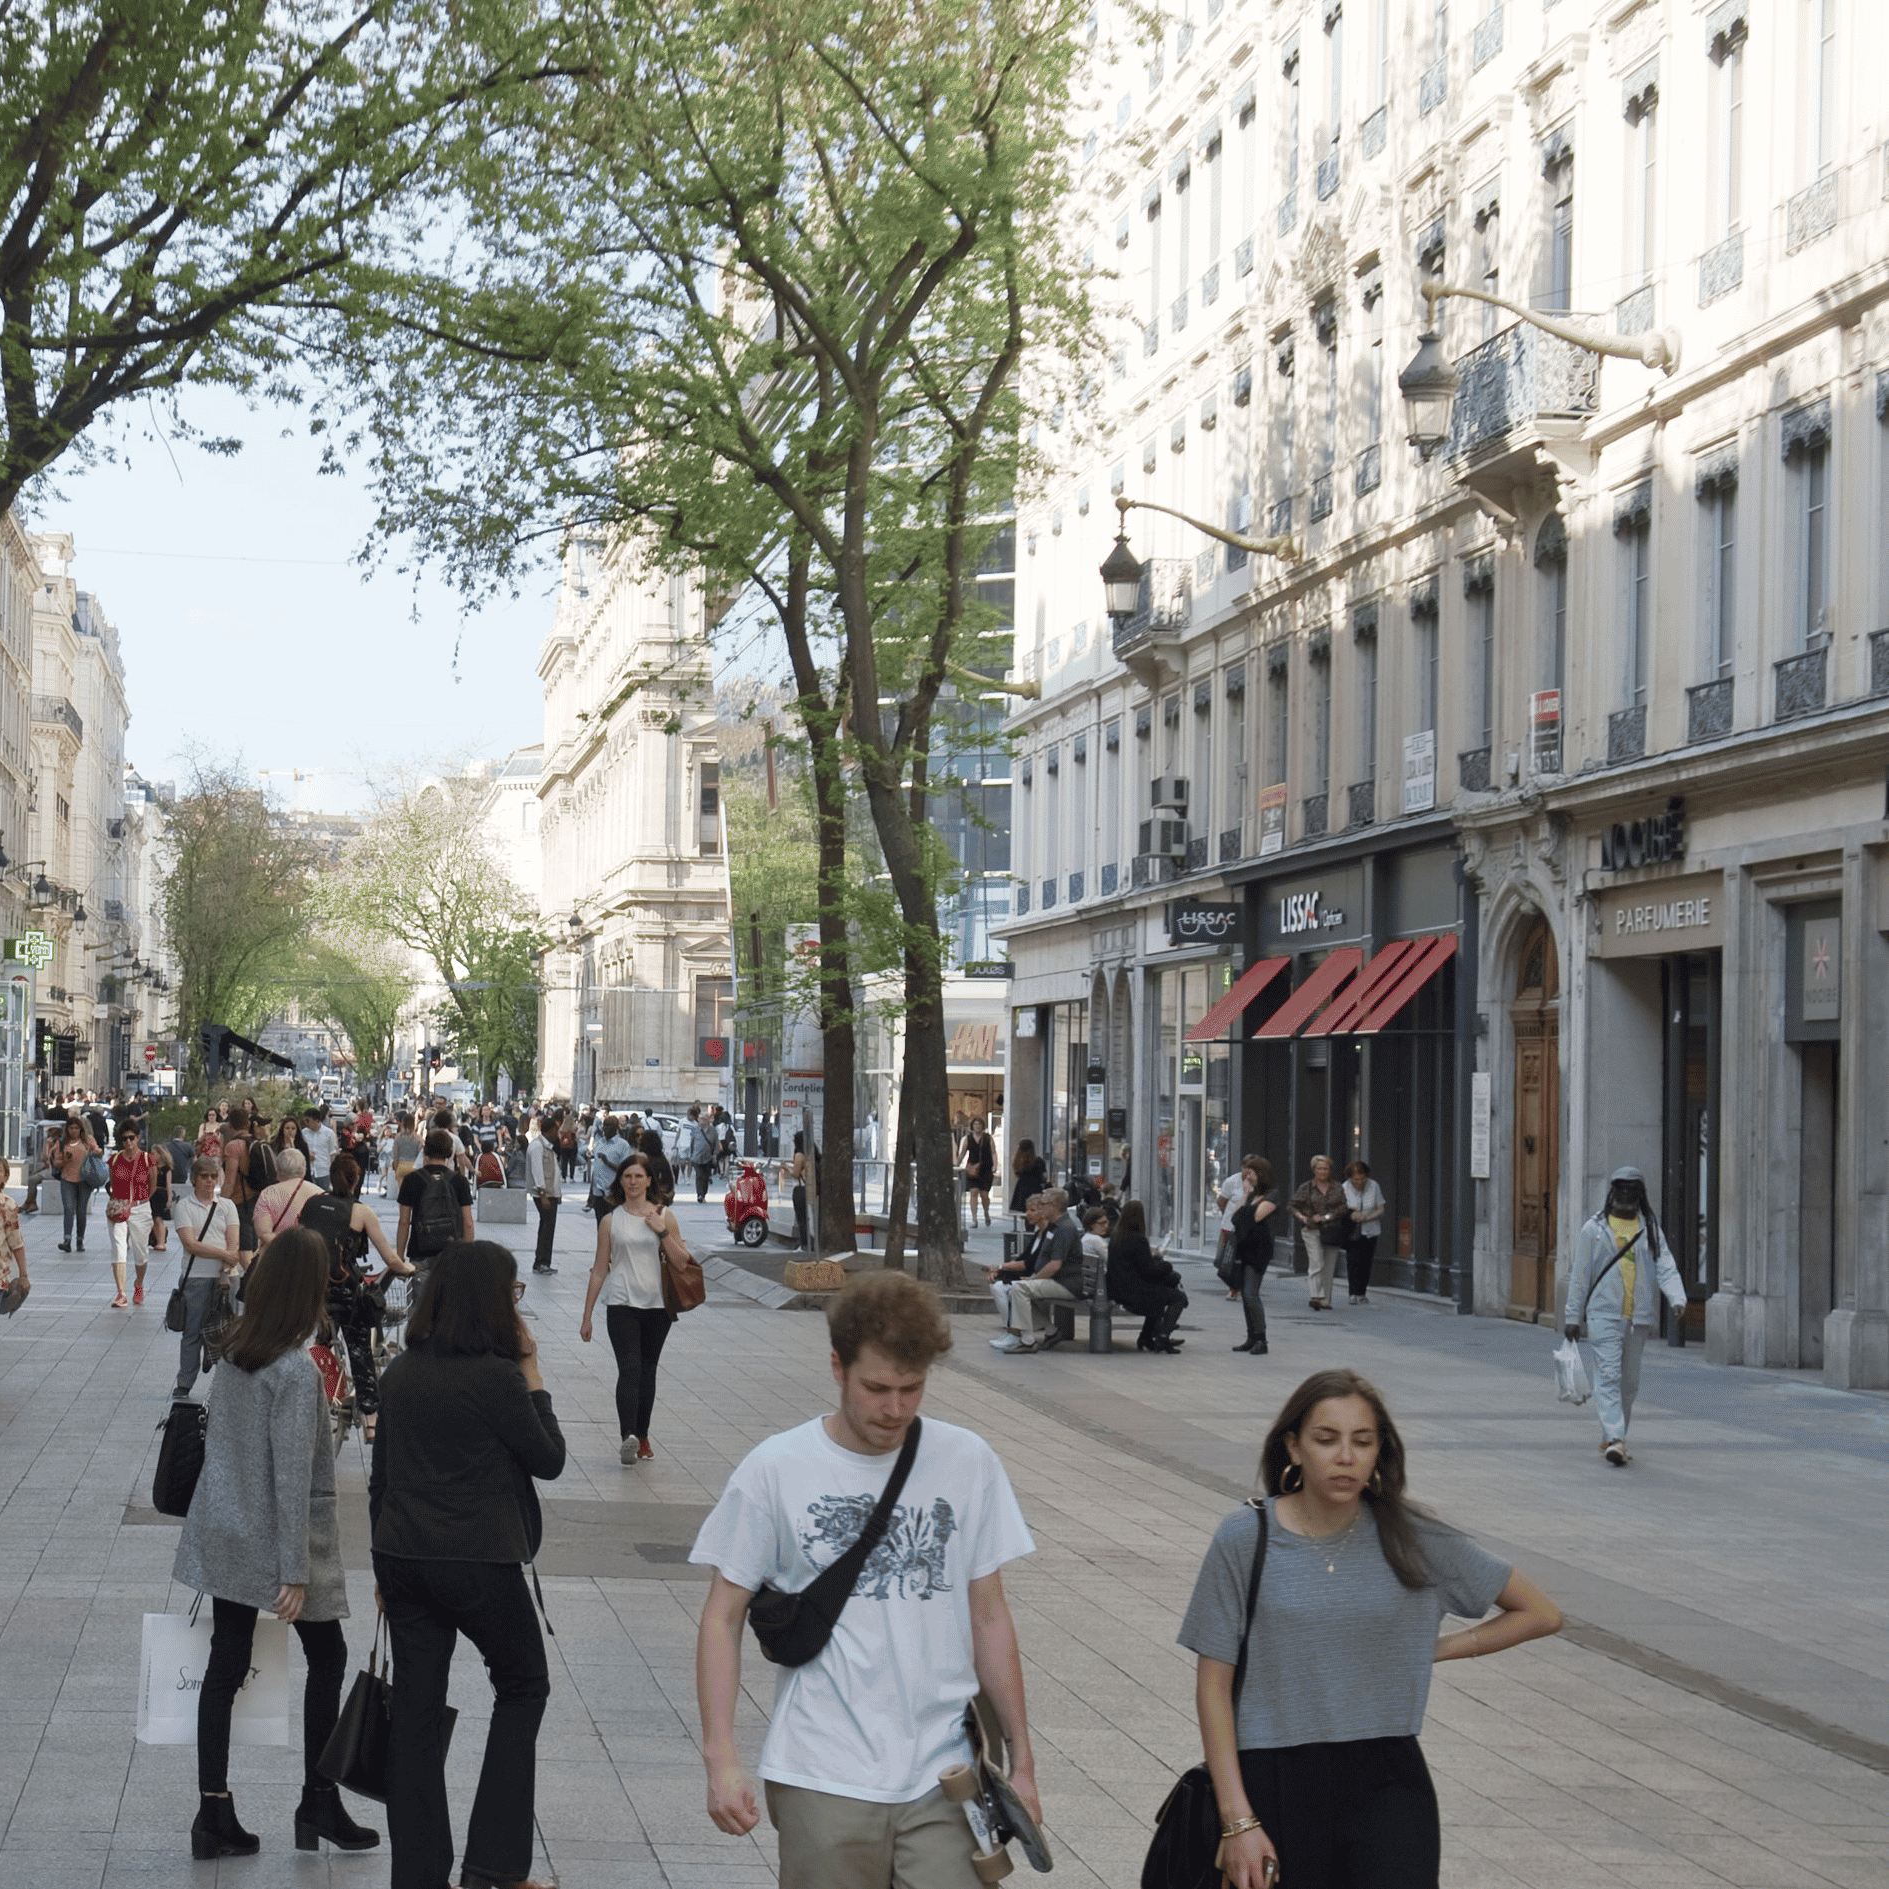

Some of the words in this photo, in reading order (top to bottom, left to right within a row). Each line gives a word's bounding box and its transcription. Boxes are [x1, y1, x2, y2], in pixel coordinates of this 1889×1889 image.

[1183, 912, 1236, 925] LISSAC
[1280, 891, 1320, 934] LISSAC
[1616, 898, 1710, 935] PARFUMERIE
[782, 1081, 825, 1093] Cordelie
